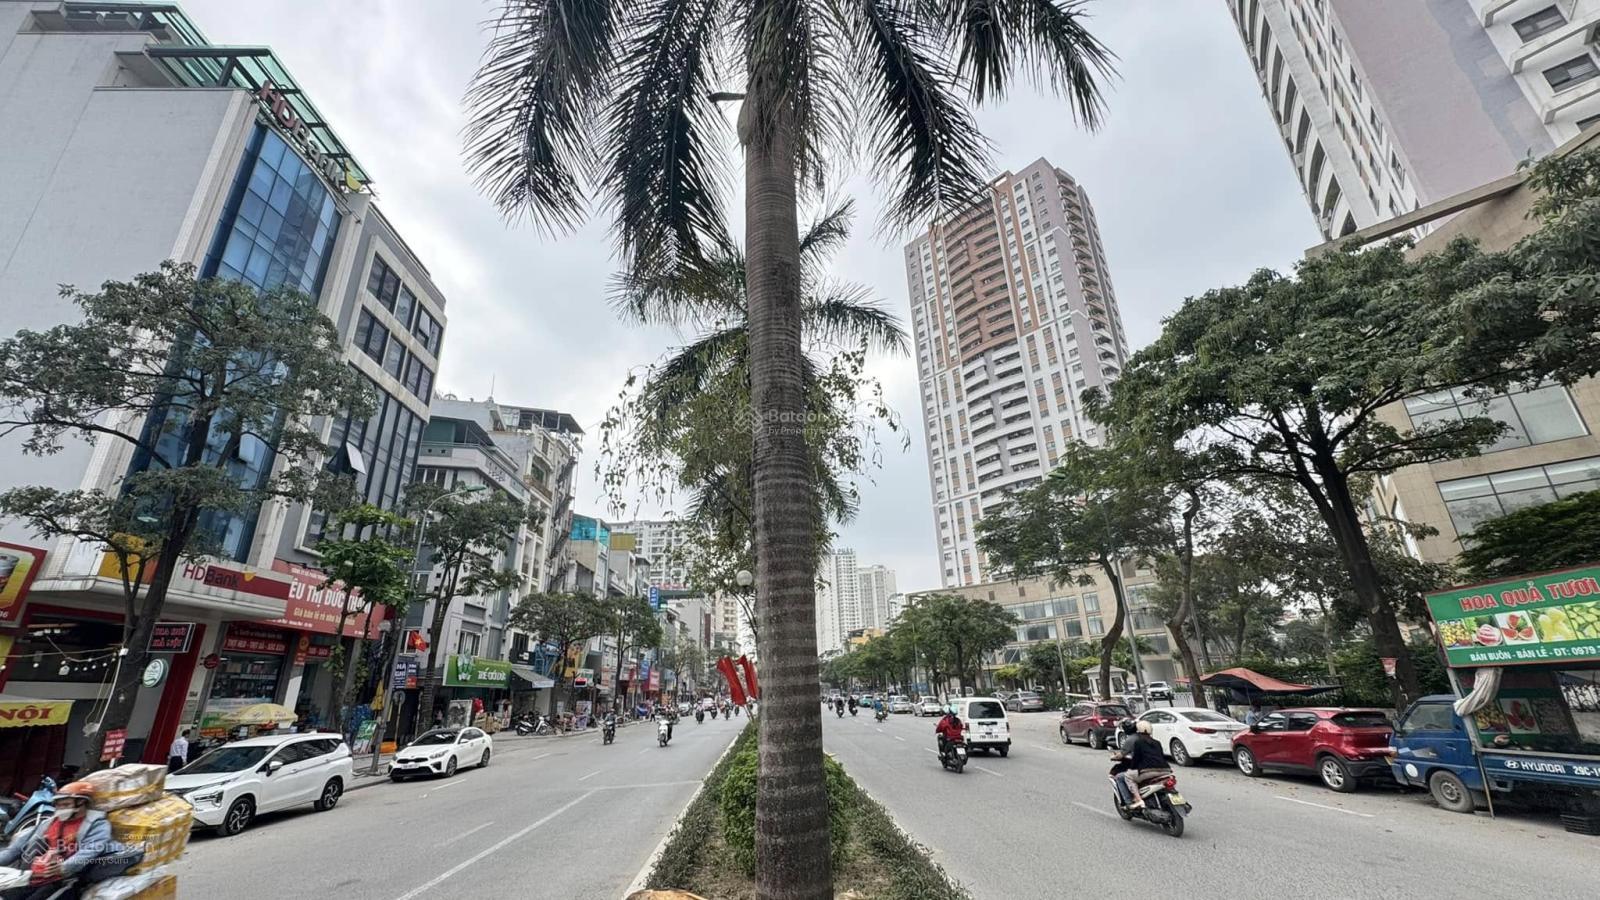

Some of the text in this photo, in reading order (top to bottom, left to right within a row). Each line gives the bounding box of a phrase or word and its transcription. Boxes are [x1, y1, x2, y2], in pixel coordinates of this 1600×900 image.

[258, 80, 340, 190] HDBank
[183, 564, 240, 589] HDBank
[289, 579, 305, 600] ÊU
[1459, 577, 1600, 611] HOA QUẢ TƯƠI
[1470, 650, 1487, 661] BÁN
[1488, 649, 1511, 660] BUÔN
[1516, 648, 1535, 658] BÁN
[1537, 646, 1548, 658] LẺ
[1572, 645, 1597, 655] 0979
[1521, 761, 1566, 774] HYUNDAI
